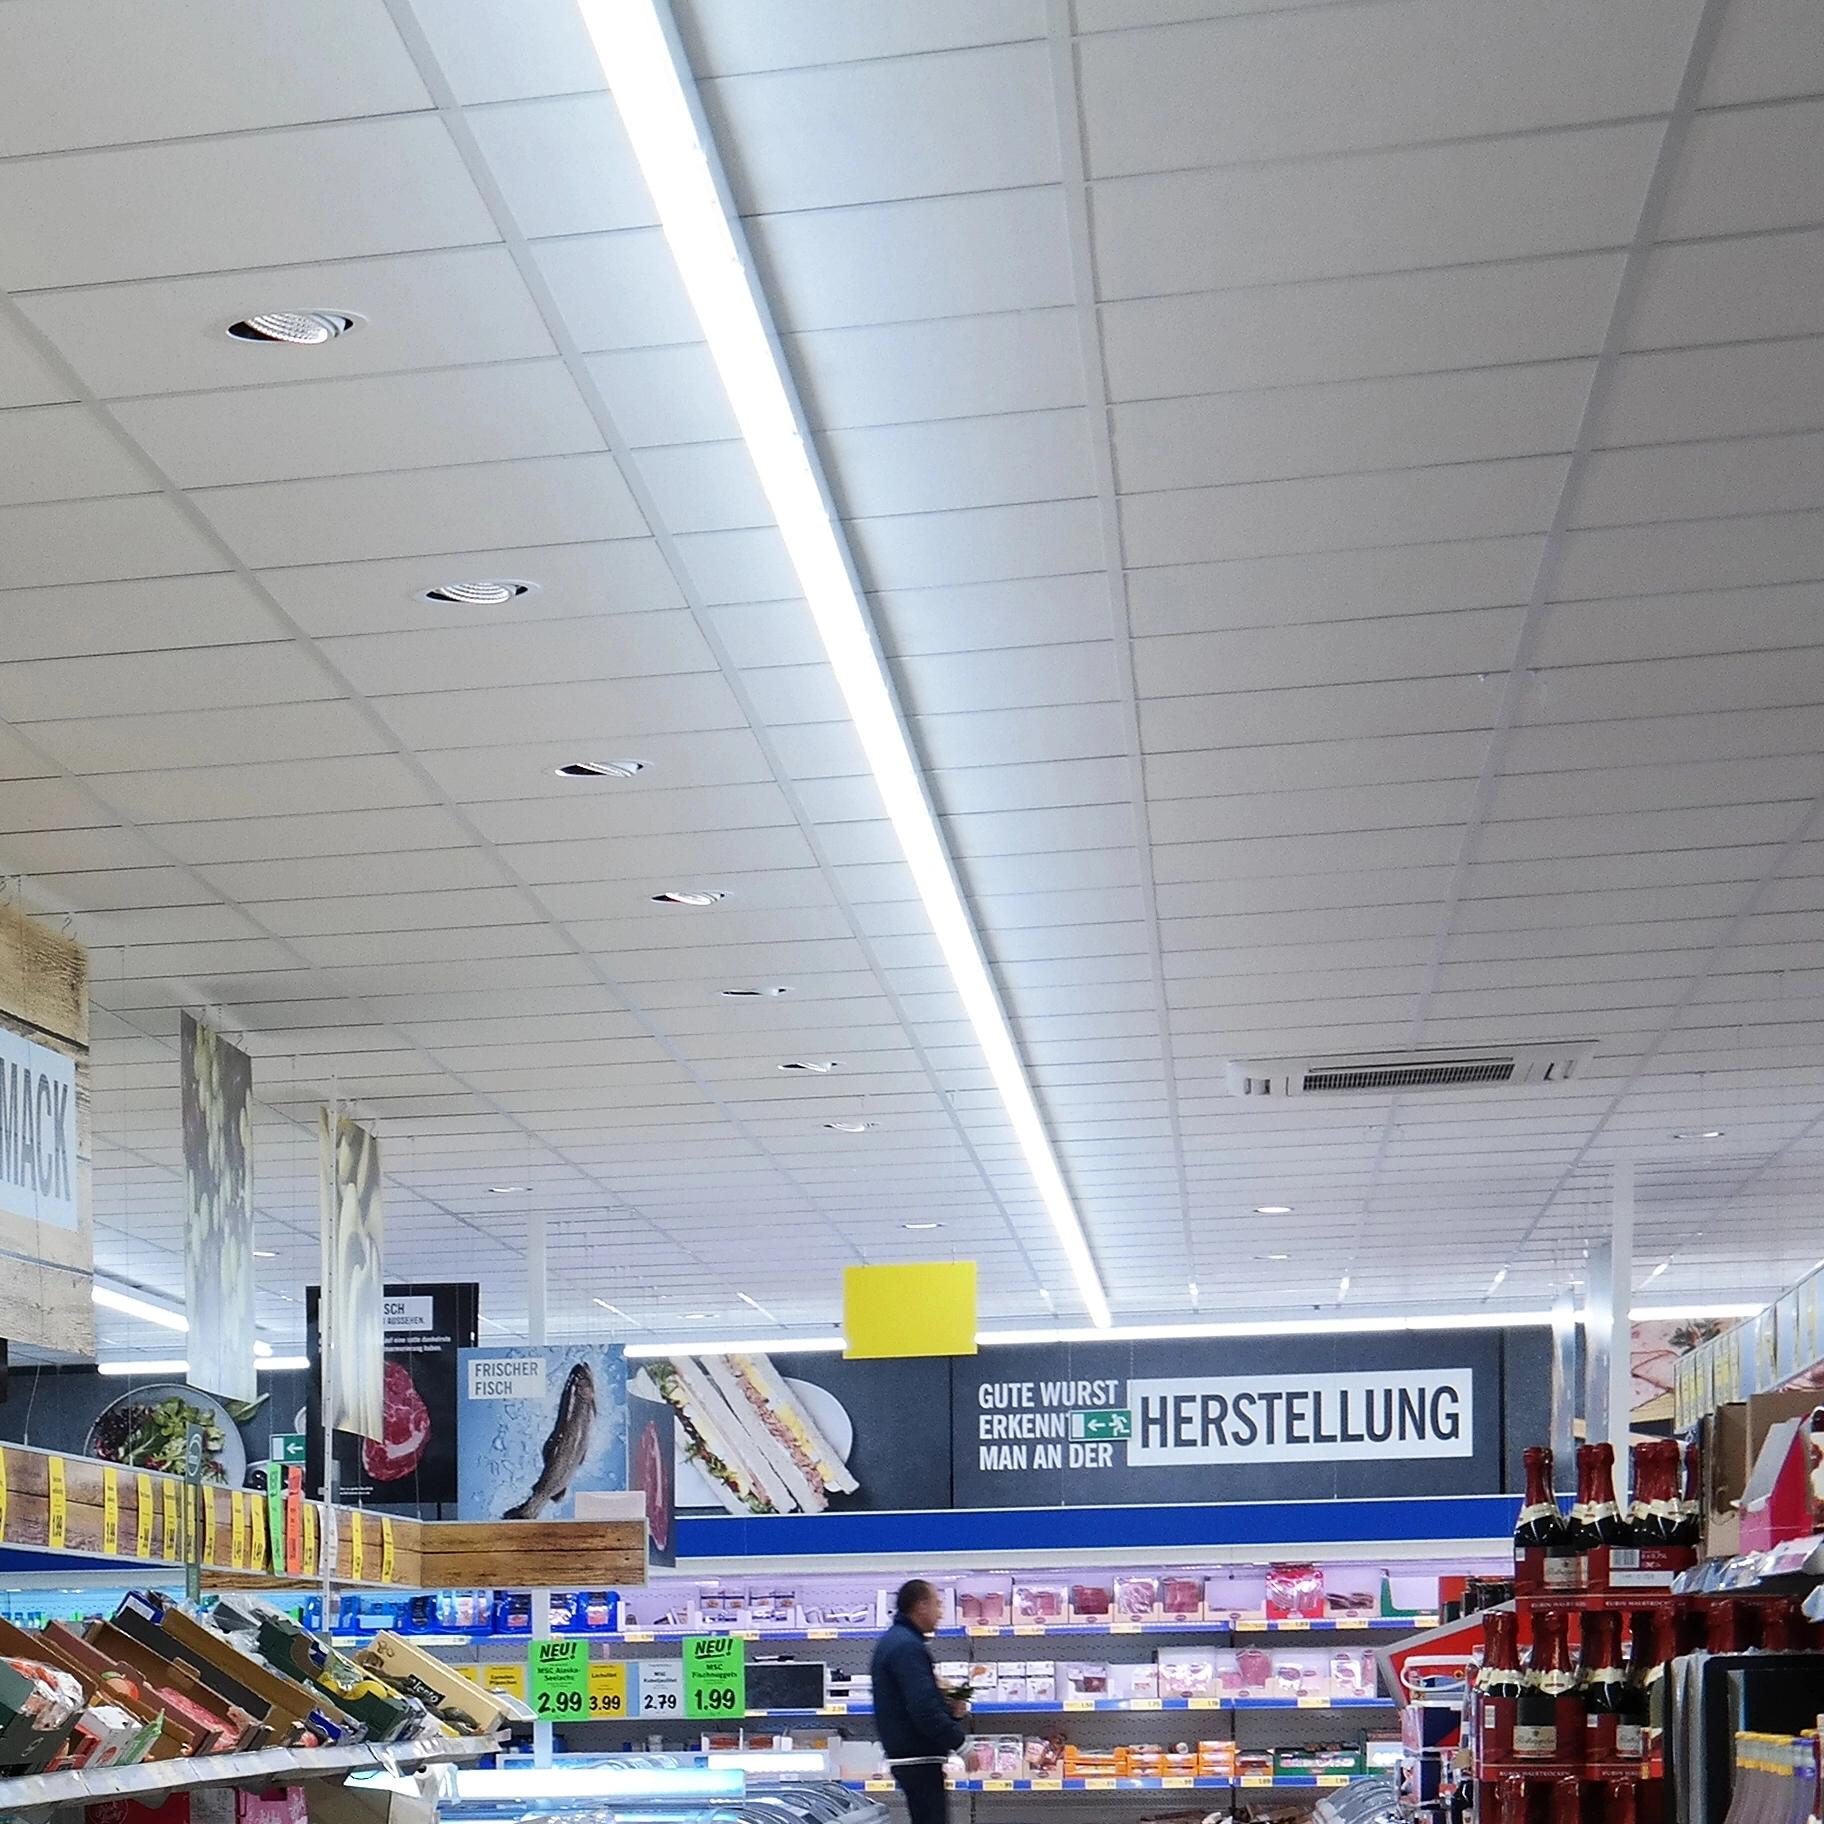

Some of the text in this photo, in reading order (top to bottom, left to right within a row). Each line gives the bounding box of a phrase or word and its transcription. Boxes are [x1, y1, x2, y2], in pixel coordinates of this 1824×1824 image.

[475, 1361, 539, 1378] FRISCHER
[475, 1381, 513, 1396] FISCH
[978, 1379, 1119, 1409] GUTE WURST
[1140, 1384, 1461, 1450] HERSTELLUNG
[978, 1441, 1114, 1471] MAN AN DER
[539, 1642, 577, 1660] NEU!
[694, 1638, 734, 1658] NEU!
[537, 1691, 582, 1714] 2.99
[589, 1695, 621, 1711] 3.99
[644, 1694, 677, 1710] 2.79
[694, 1688, 737, 1711] 1.99
